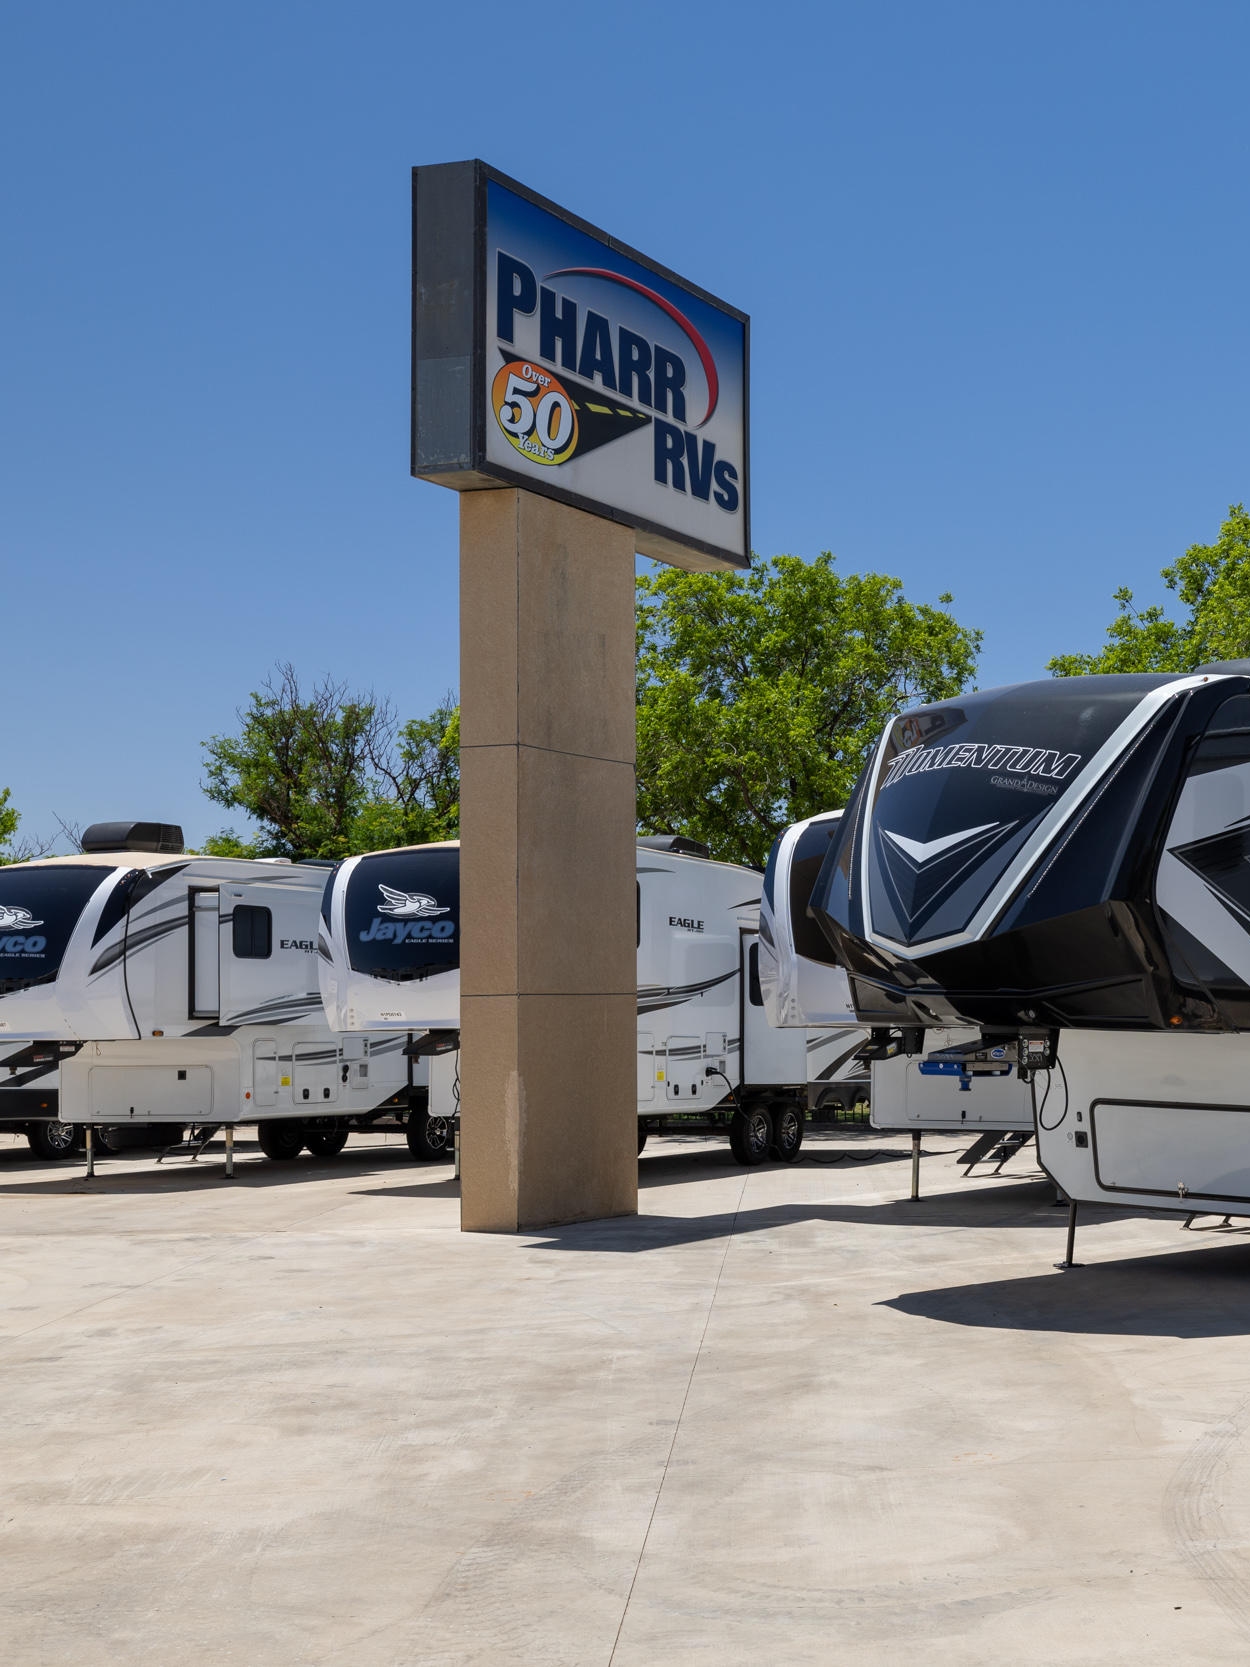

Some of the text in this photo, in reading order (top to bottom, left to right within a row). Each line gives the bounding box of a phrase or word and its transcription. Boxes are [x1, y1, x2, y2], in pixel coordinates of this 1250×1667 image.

[496, 249, 687, 424] PHARR
[522, 364, 551, 388] Over
[499, 371, 574, 455] 50
[518, 432, 555, 461] Years
[653, 415, 739, 513] RVs
[880, 743, 1081, 791] MOMENTUM
[990, 775, 1020, 788] GRAND
[1026, 780, 1059, 794] DESIGN
[360, 917, 455, 944] Jayco
[668, 916, 705, 930] EAGLE
[280, 939, 318, 950] EAGL
